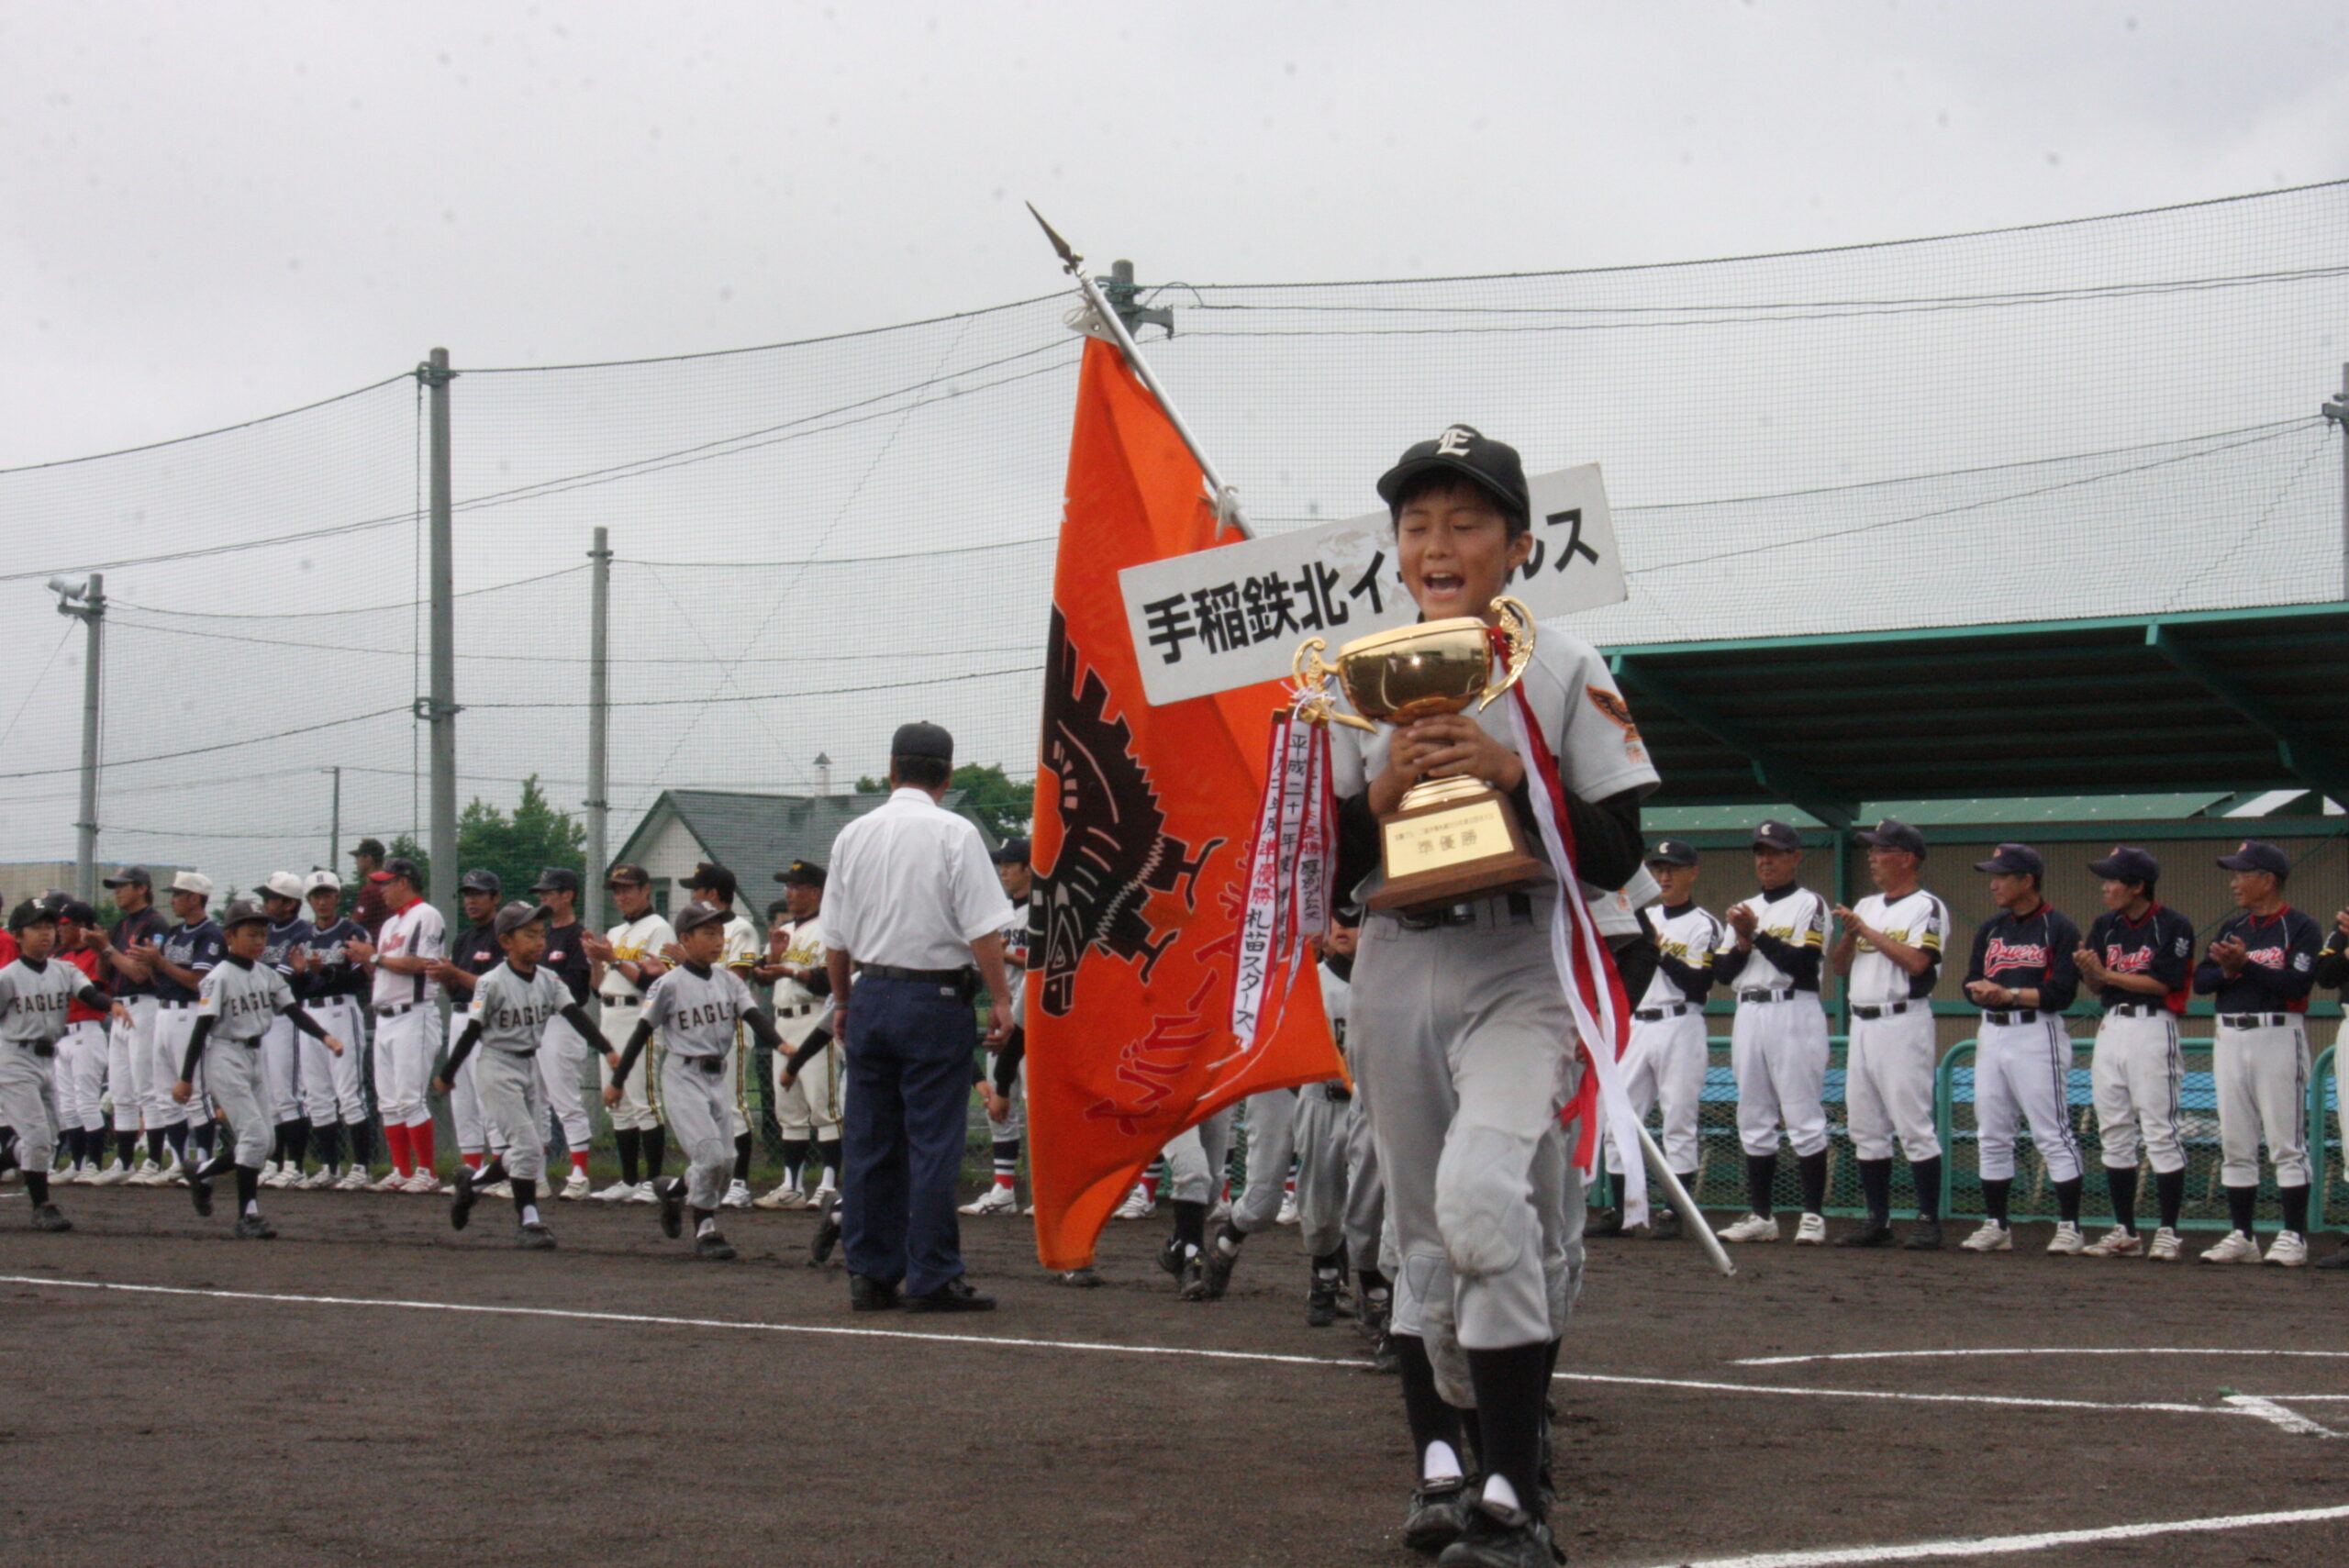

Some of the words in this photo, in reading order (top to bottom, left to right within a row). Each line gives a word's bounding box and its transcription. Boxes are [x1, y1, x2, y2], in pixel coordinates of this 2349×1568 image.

[1437, 432, 1475, 457] E
[1143, 507, 1599, 664] 手稲鉄北イス
[1984, 937, 2048, 976] Pwers
[230, 990, 277, 1018] EAGL
[499, 1004, 550, 1029] EAGLE
[678, 999, 731, 1031] EAGL
